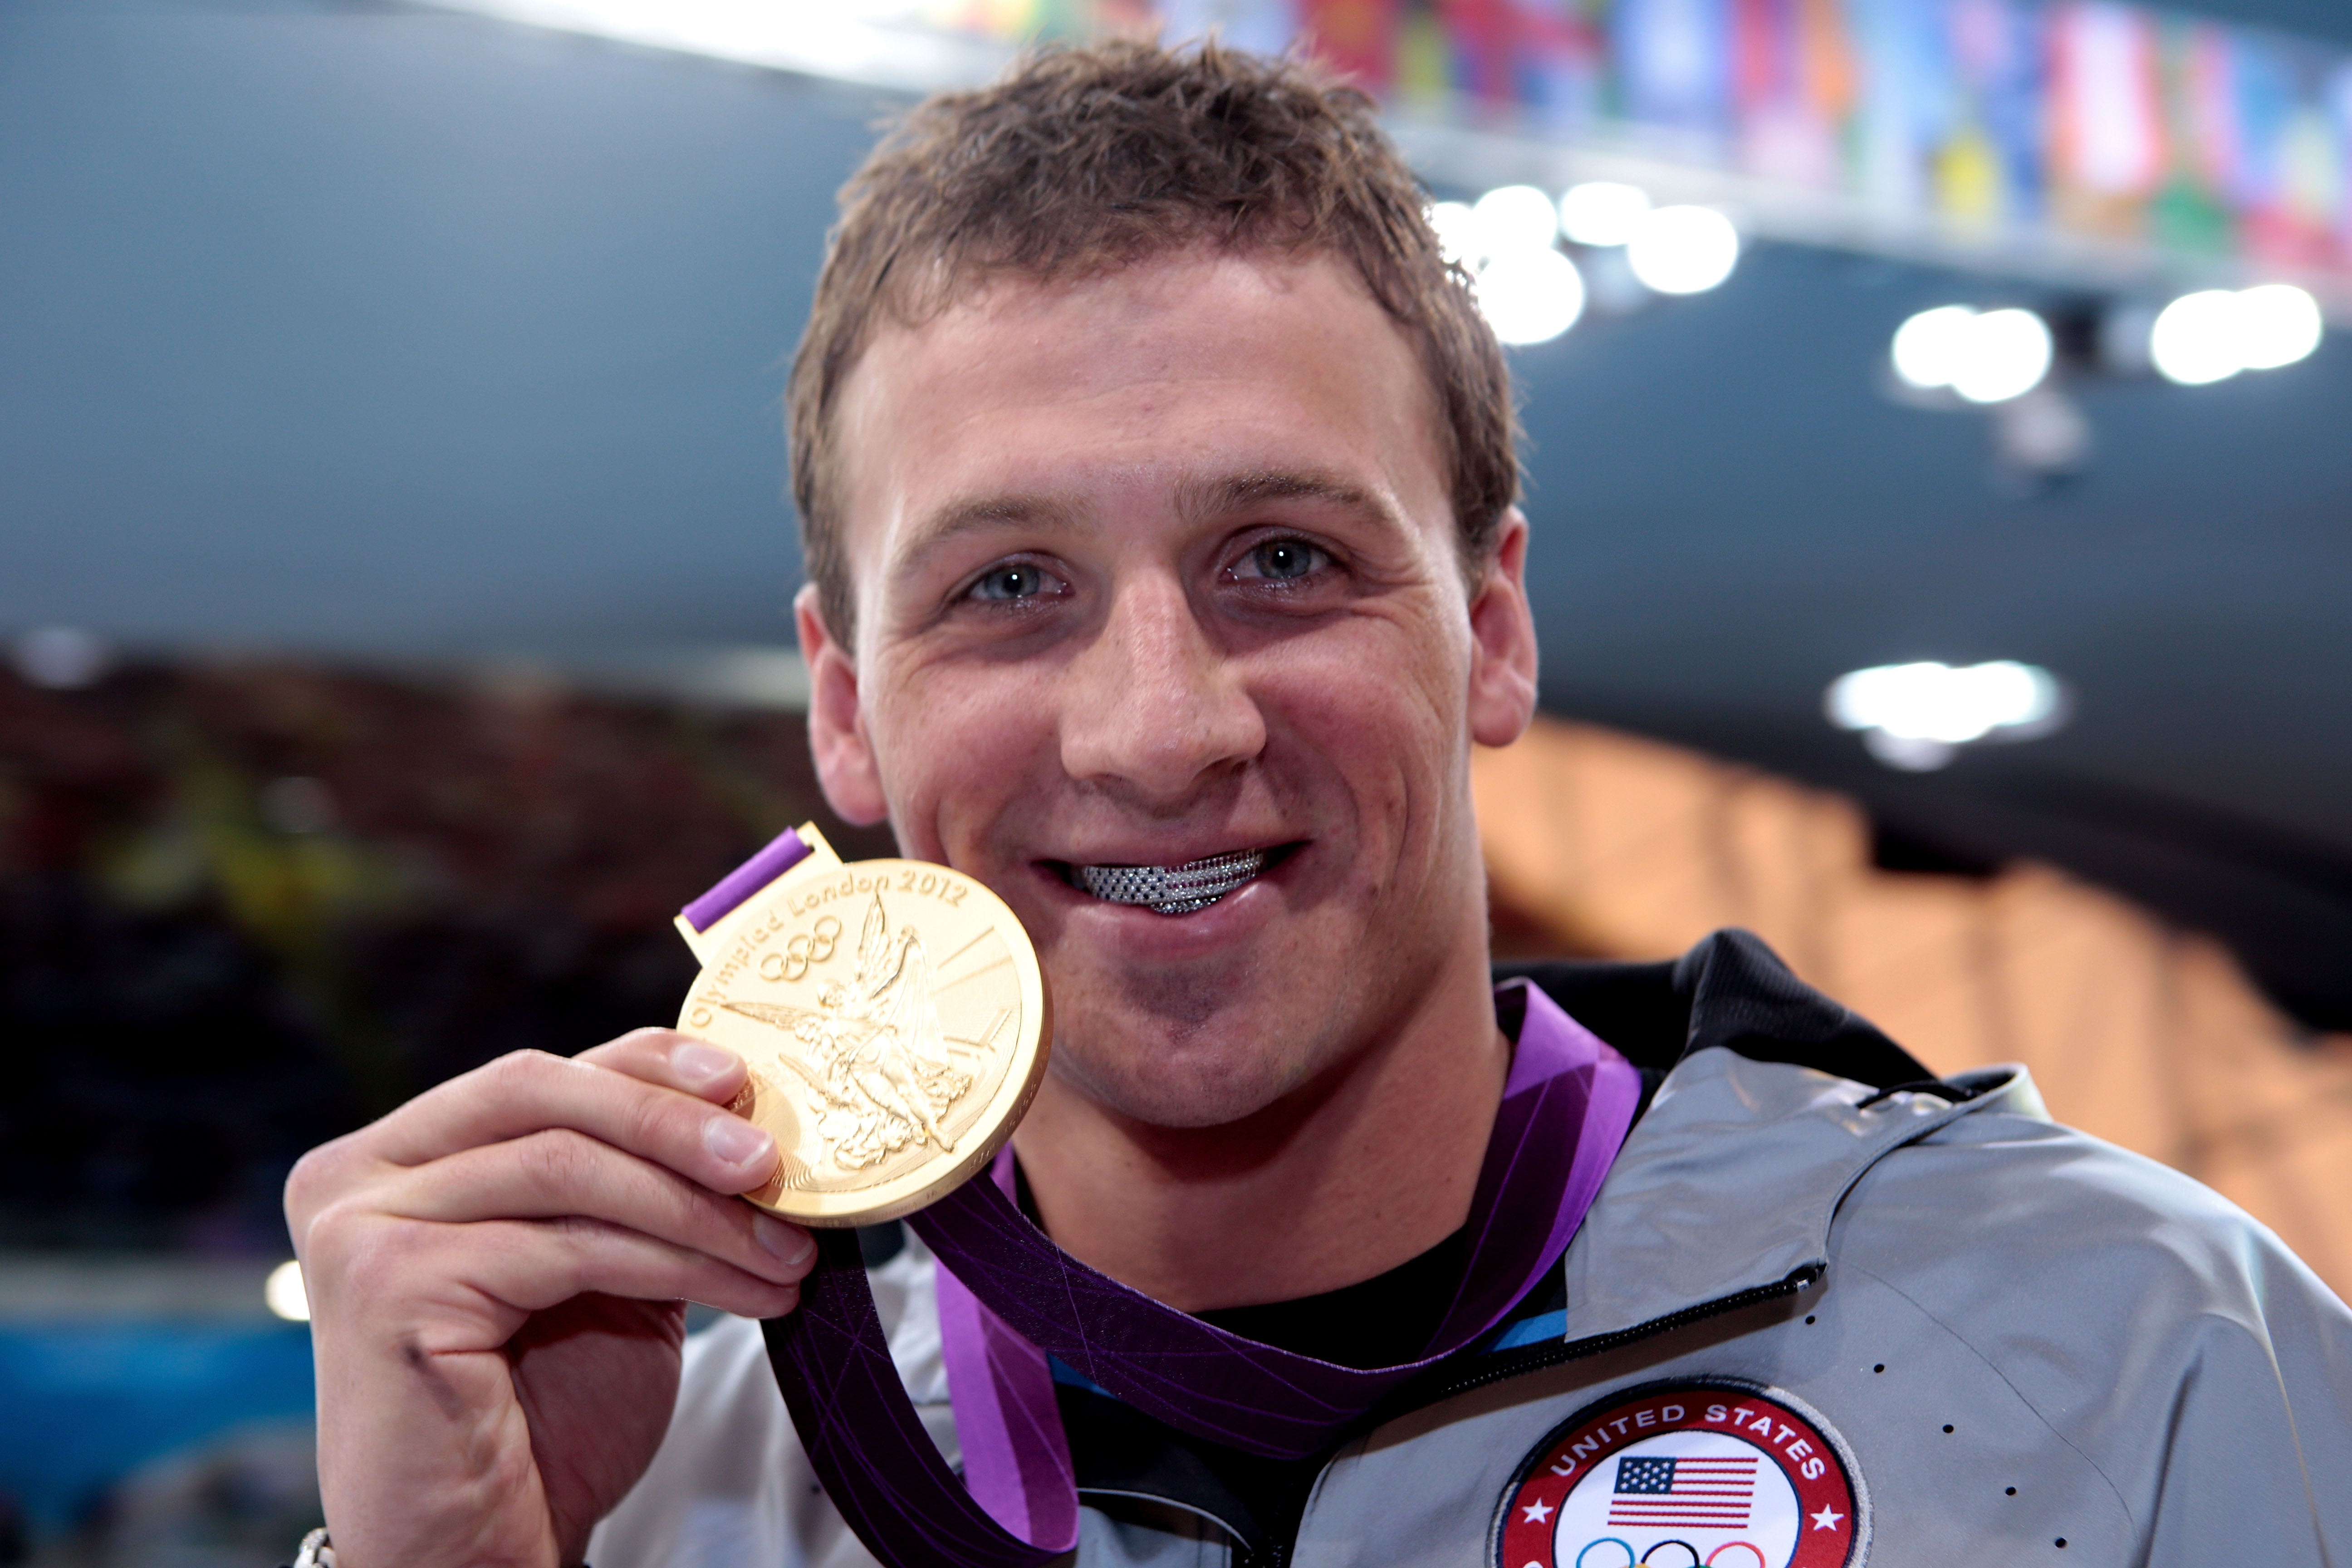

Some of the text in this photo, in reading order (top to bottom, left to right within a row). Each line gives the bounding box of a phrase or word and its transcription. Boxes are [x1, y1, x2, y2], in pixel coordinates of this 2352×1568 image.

[690, 870, 967, 1028] Olympiad London 2012
[1550, 1404, 1826, 1481] UNITED STATES
